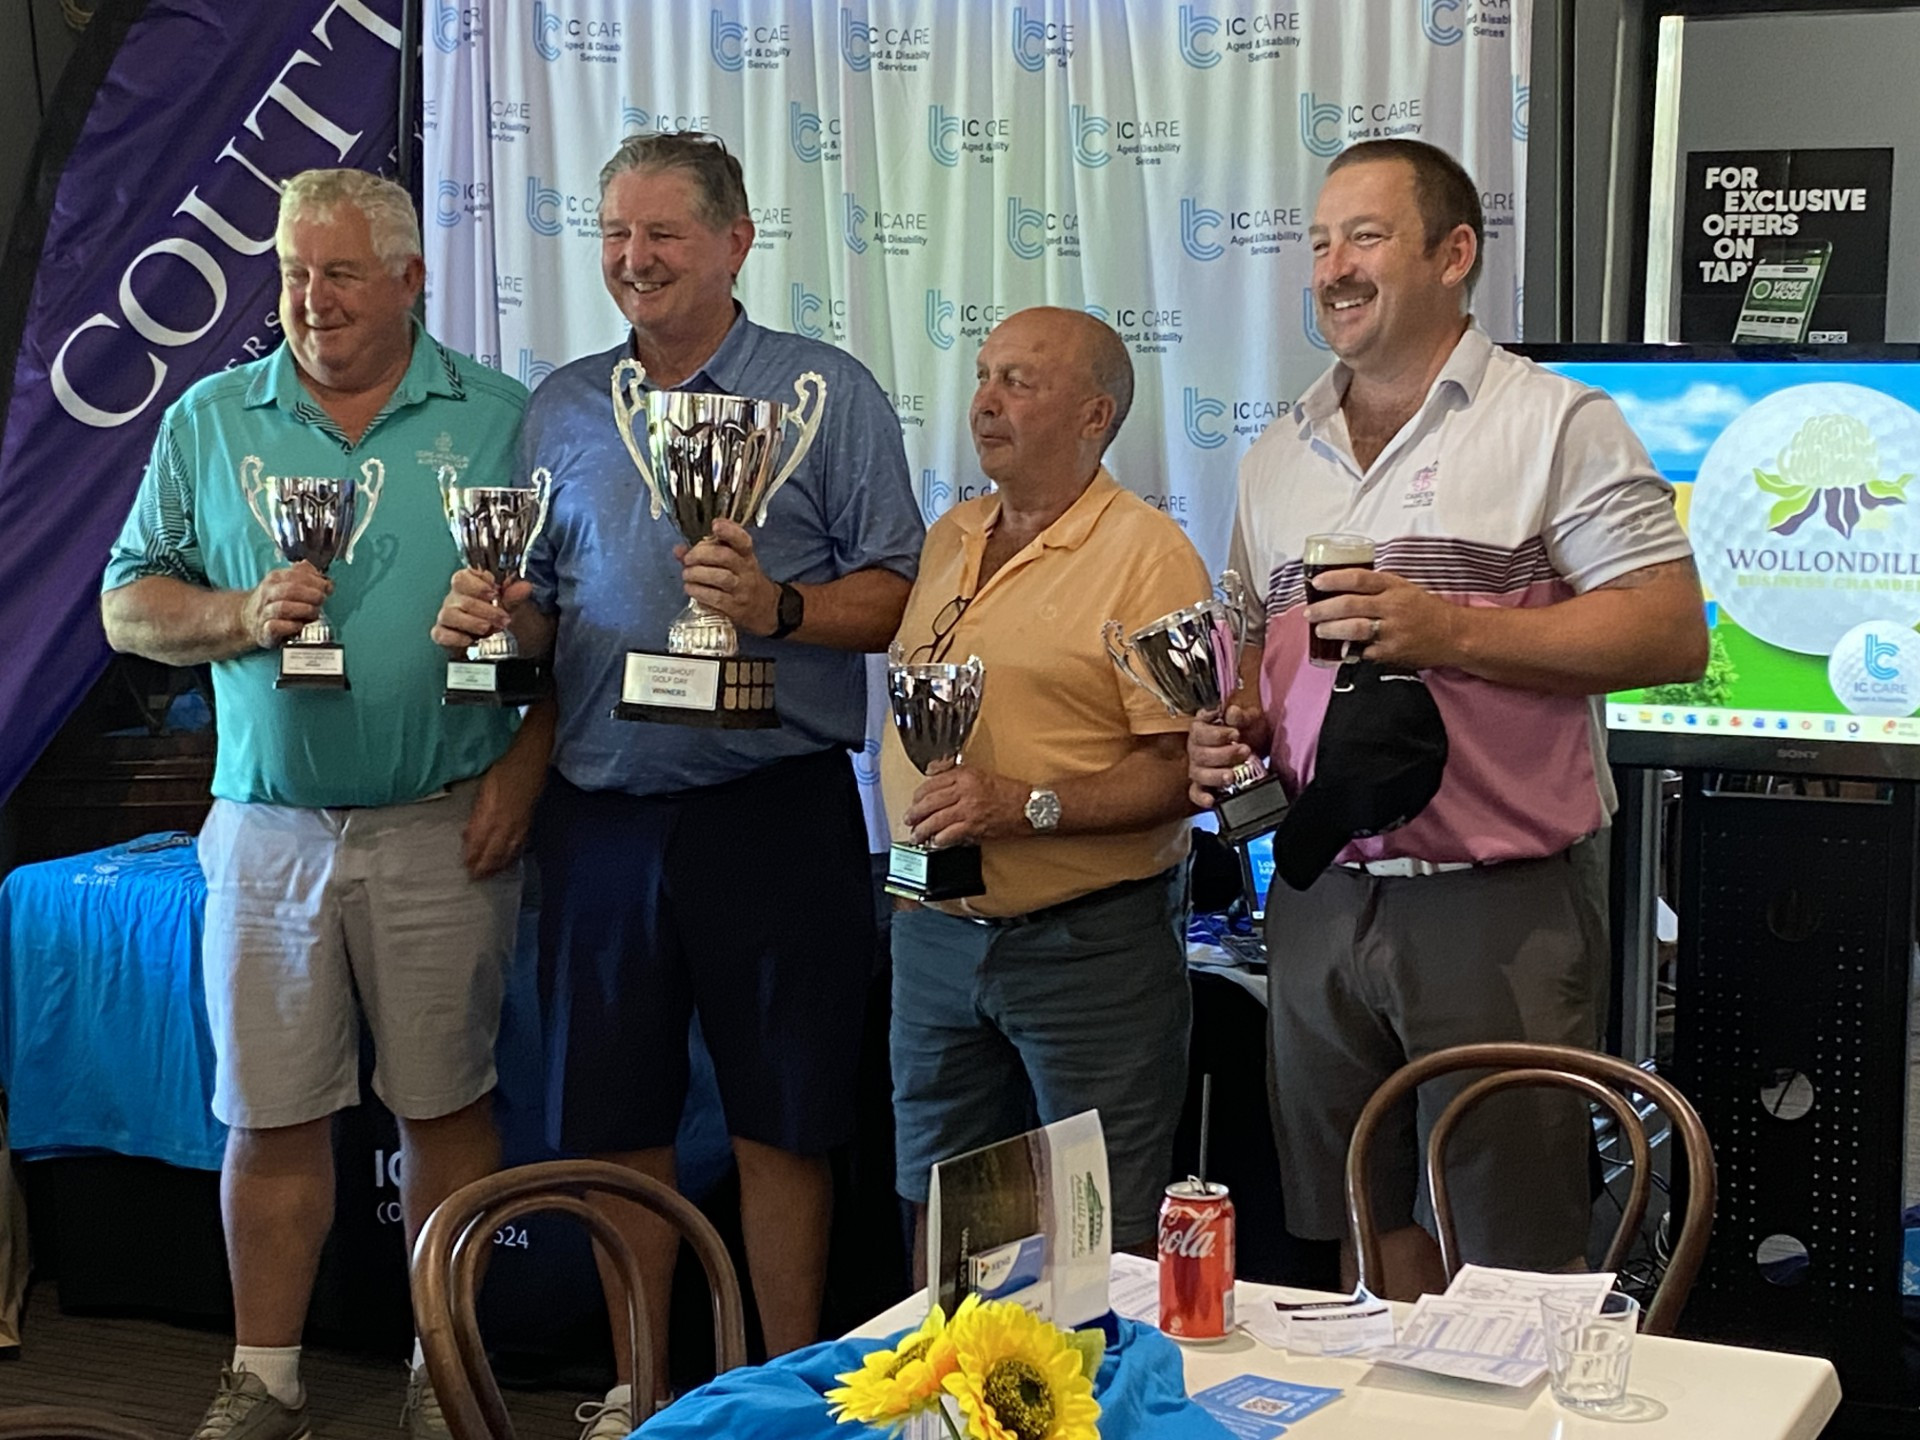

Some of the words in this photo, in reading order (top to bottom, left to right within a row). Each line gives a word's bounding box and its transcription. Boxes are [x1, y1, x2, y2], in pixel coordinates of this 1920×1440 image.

[1046, 23, 1057, 40] C
[1226, 17, 1246, 37] IC
[1253, 12, 1299, 33] CARE
[869, 27, 878, 44] C
[885, 27, 930, 46] CARE
[755, 49, 762, 57] &
[885, 51, 892, 60] &
[1226, 41, 1252, 53] Aged
[580, 53, 617, 63] Services
[878, 61, 917, 72] Services
[1348, 105, 1364, 125] IC
[1371, 99, 1421, 121] CARE
[656, 115, 668, 131] IC
[962, 119, 979, 137] IC
[1117, 121, 1139, 139] IC
[1373, 127, 1380, 137] &
[961, 142, 983, 153] Aged
[1705, 167, 1758, 189] FOR
[1725, 189, 1866, 212] EXCLUSIVE
[751, 207, 792, 224] CARE
[881, 213, 927, 230] CARE
[1046, 213, 1056, 230] C
[1231, 212, 1250, 230] IC
[1254, 208, 1302, 228] CARE
[1703, 214, 1799, 236] OFFERS
[1714, 238, 1754, 259] ON
[961, 304, 978, 322] IC
[1117, 310, 1135, 327] IC
[1142, 310, 1182, 328] CARE
[961, 327, 982, 338] Aged
[985, 327, 992, 336] &
[1143, 333, 1150, 342] &
[1234, 402, 1249, 420] IC
[1253, 401, 1290, 419] CAR
[1726, 548, 1920, 575] WOLLONDILL
[1738, 574, 1825, 588] BUSINESS
[647, 666, 668, 674] YOUR
[669, 667, 696, 676] SHOUT
[652, 675, 671, 683] GOLF
[673, 677, 688, 685] DAY
[1854, 682, 1868, 693] IC
[1871, 683, 1908, 694] CARE
[652, 688, 687, 697] WINNERS
[1777, 748, 1819, 759] SONY
